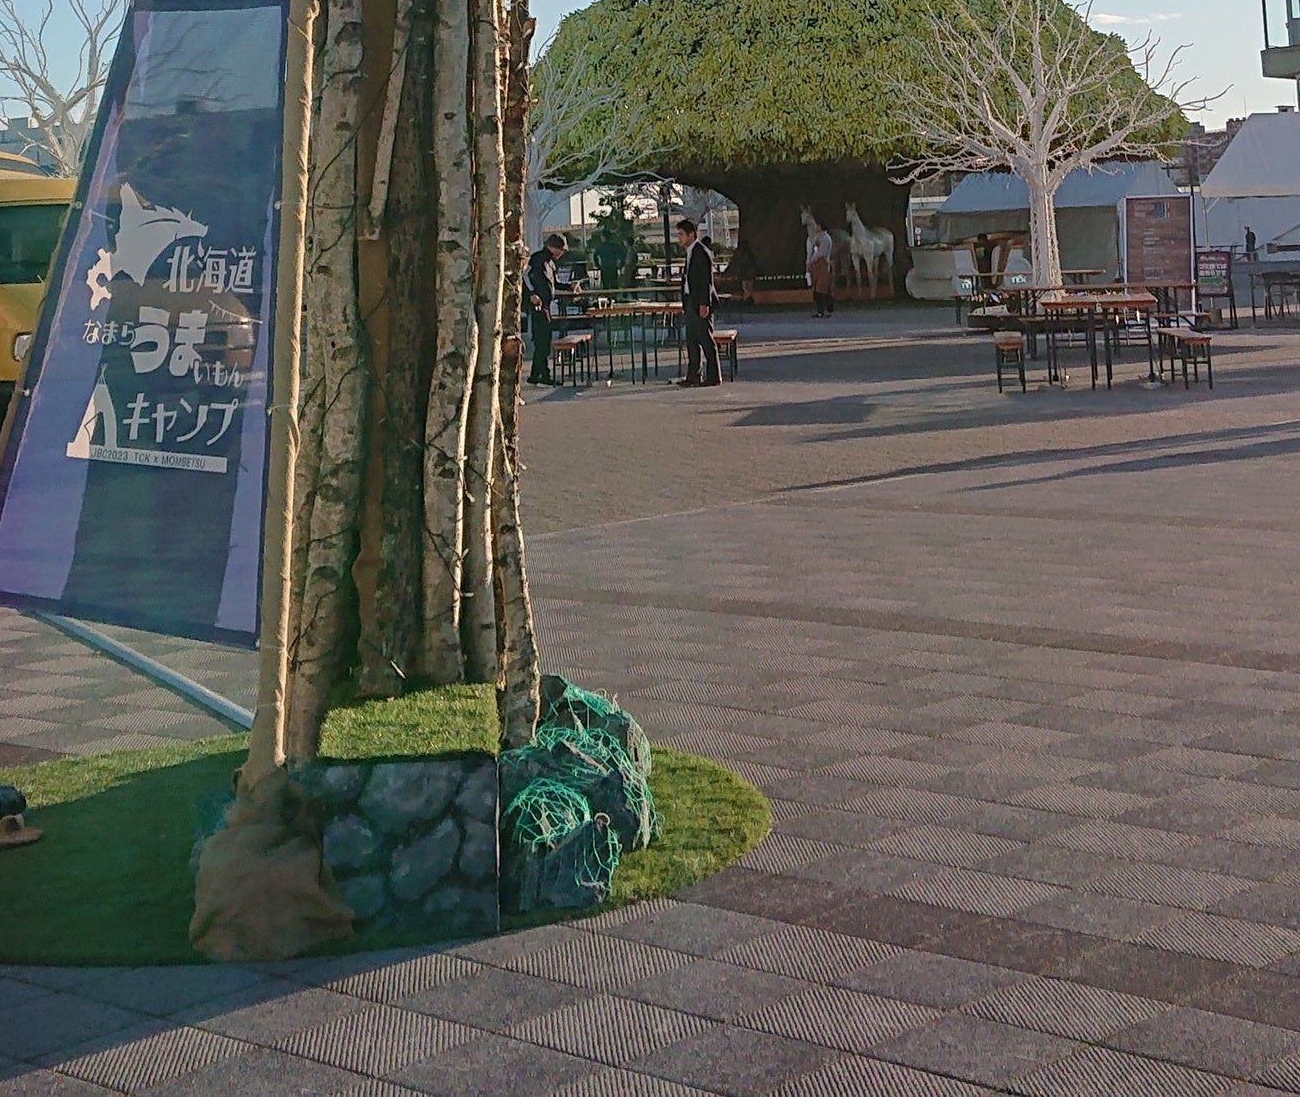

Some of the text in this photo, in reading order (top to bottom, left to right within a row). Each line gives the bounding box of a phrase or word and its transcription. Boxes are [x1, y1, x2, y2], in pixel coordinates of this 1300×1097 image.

[162, 245, 257, 294] 北海道
[82, 318, 137, 346] なまら
[122, 392, 240, 446] キャンプ
[91, 449, 129, 462] JBC2023
[133, 451, 151, 463] TCK
[160, 455, 206, 469] MOMBETSU
